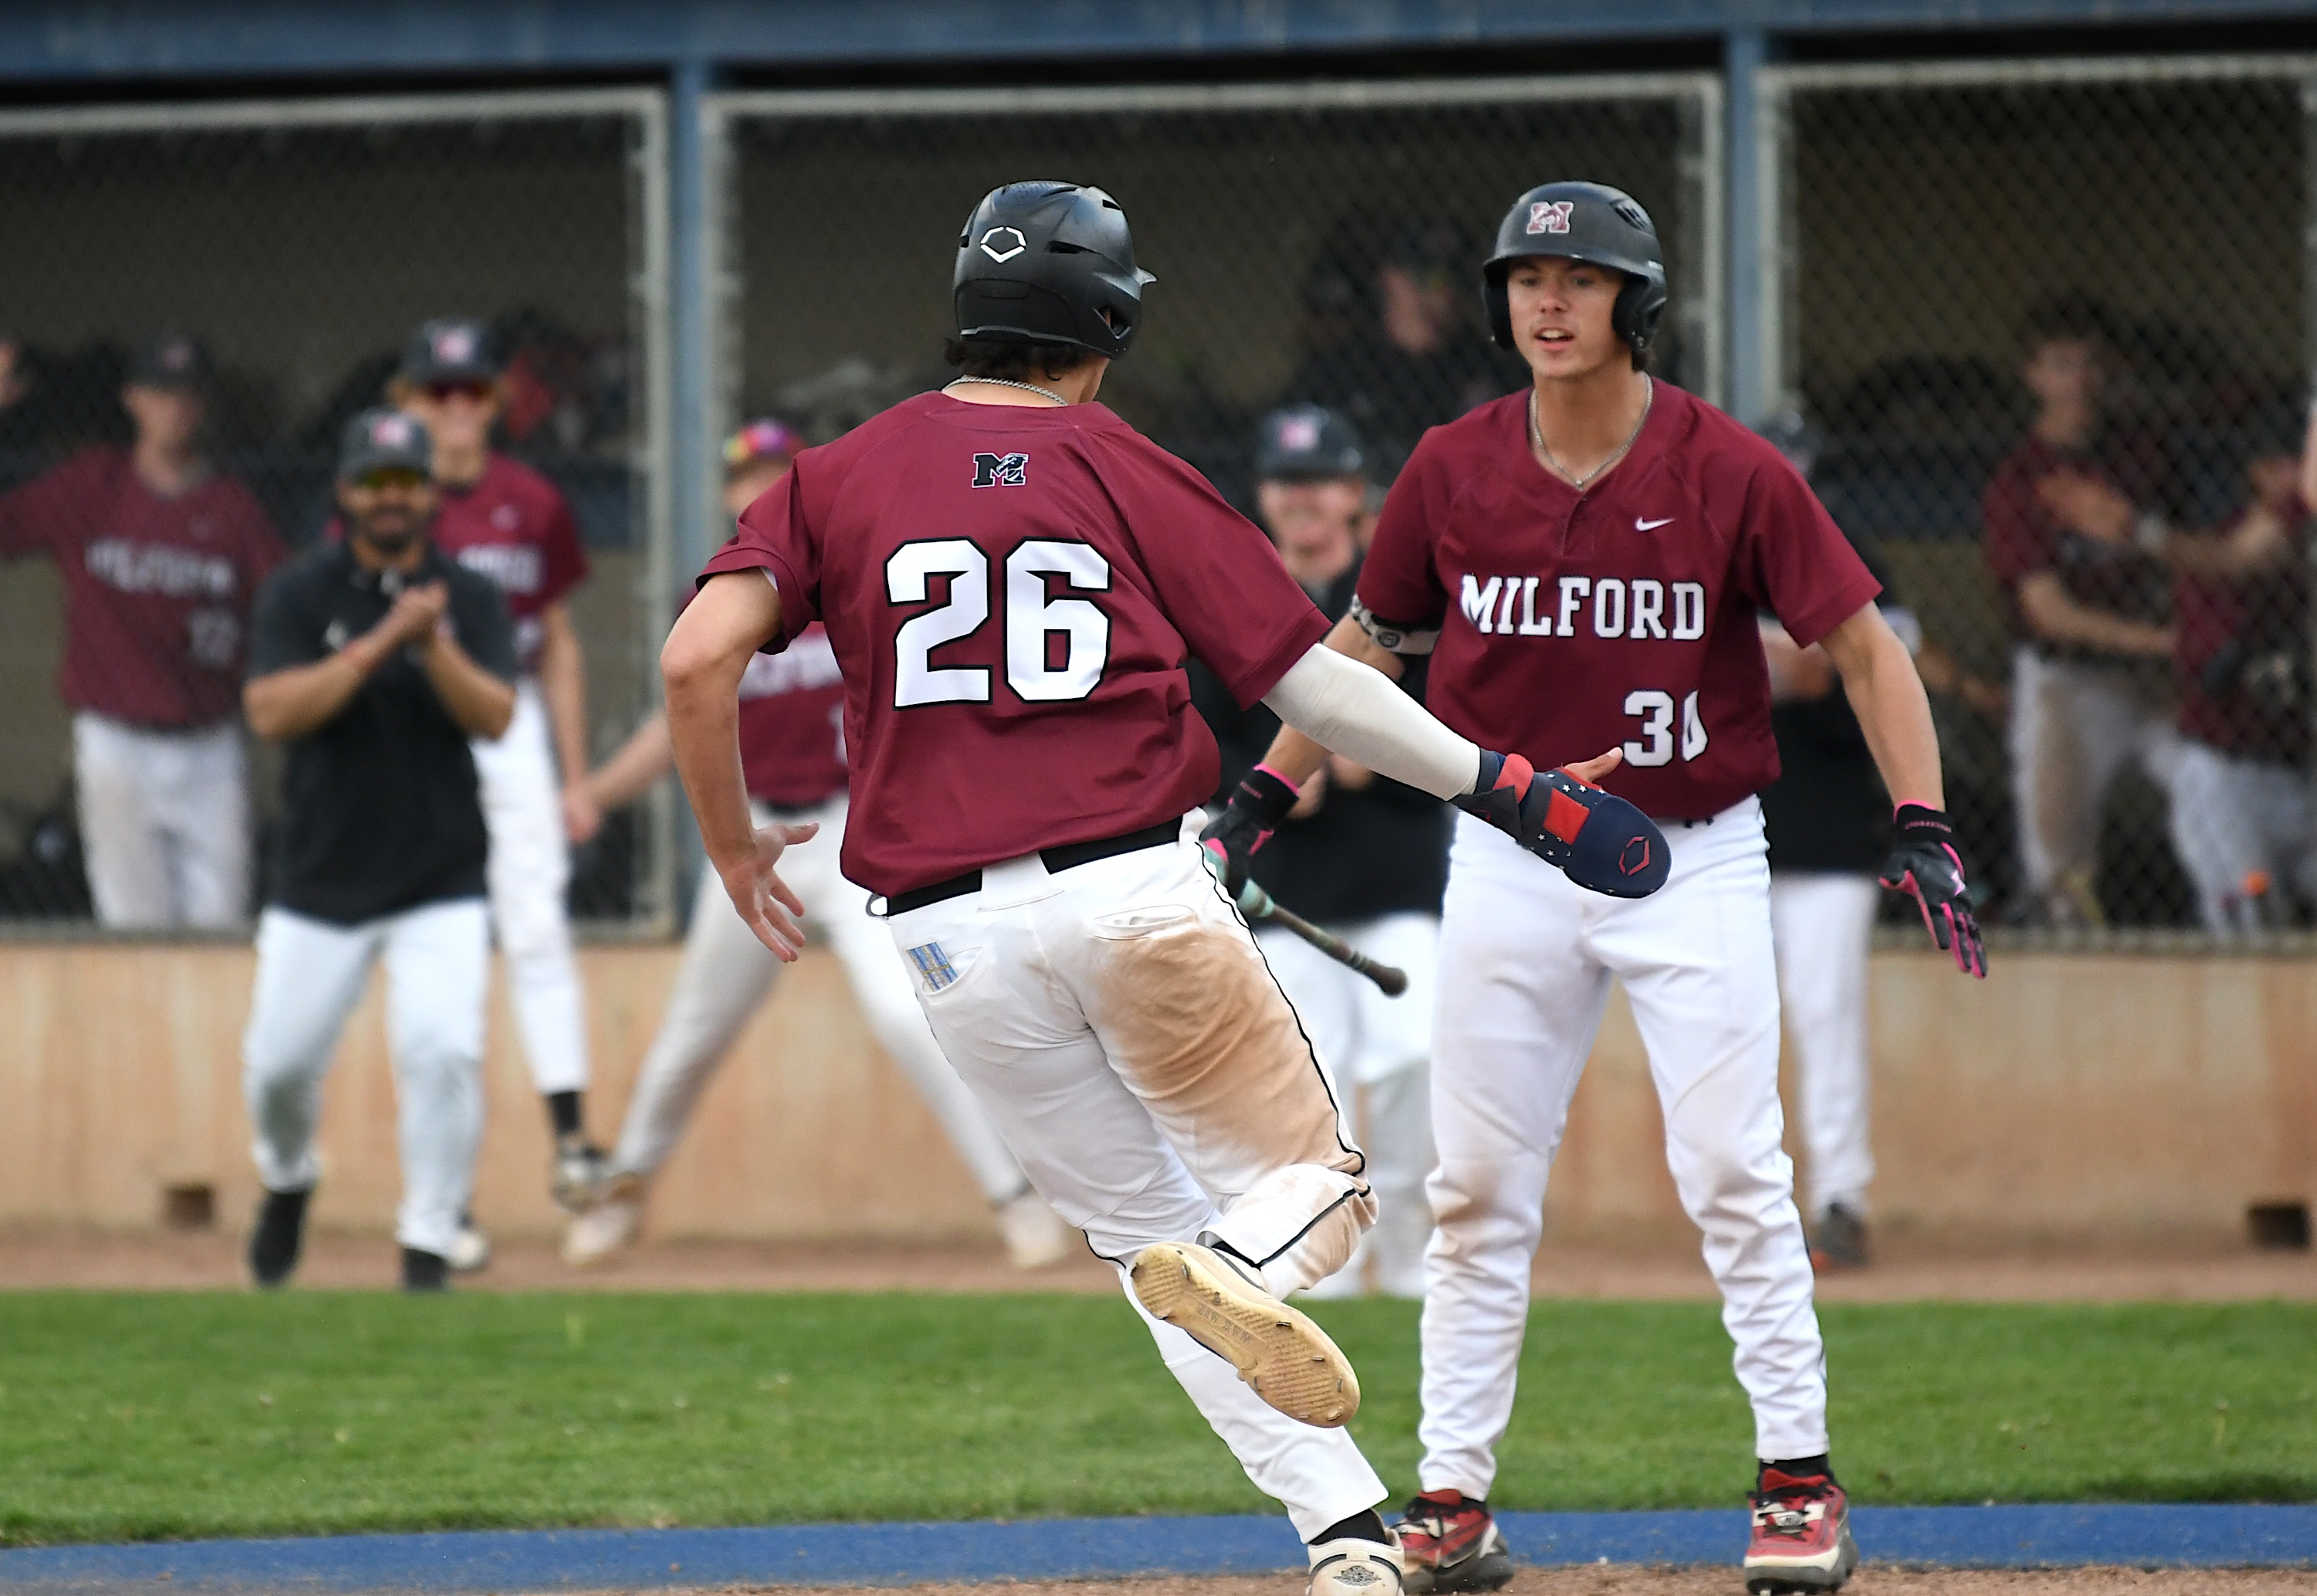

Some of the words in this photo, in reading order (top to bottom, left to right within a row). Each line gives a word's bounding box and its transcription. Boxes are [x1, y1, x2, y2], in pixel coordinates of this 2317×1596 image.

[1526, 201, 1574, 235] M
[971, 452, 1030, 489] M
[883, 536, 1113, 711] 26
[1460, 574, 1706, 642] MILFORD
